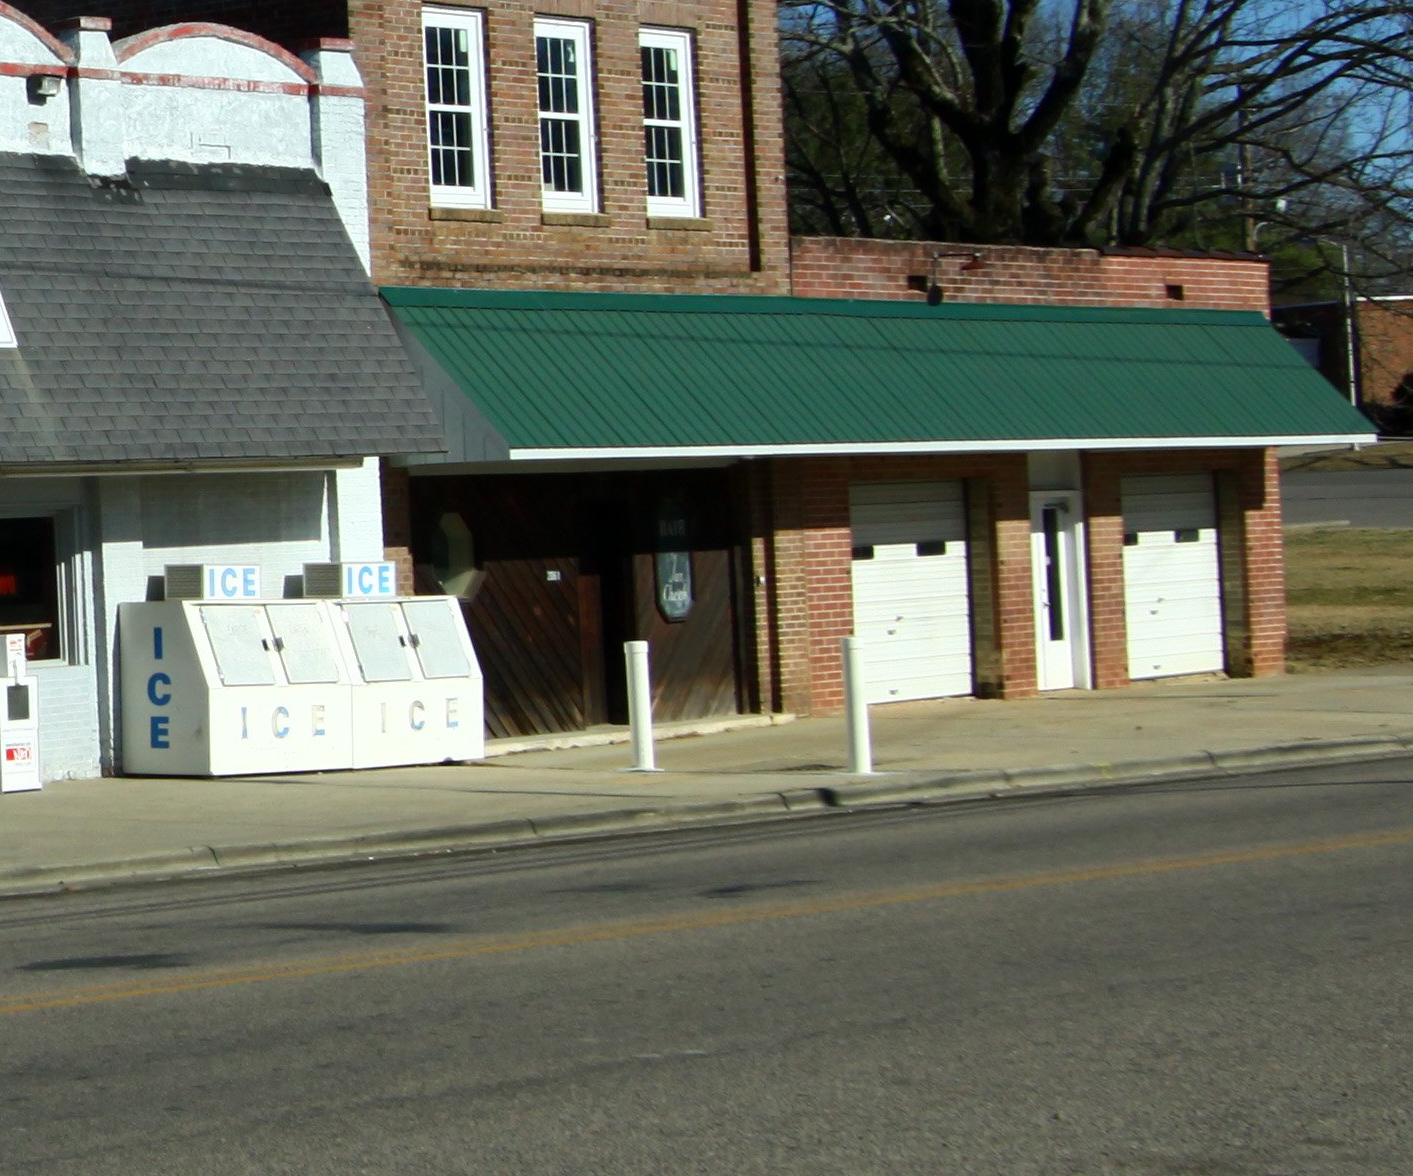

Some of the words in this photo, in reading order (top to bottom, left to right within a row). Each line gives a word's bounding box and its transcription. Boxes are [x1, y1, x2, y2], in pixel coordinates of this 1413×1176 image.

[209, 568, 255, 597] ICE
[347, 566, 390, 594] ICE
[147, 627, 171, 748] ICE
[240, 704, 326, 739] ICE
[379, 697, 459, 734] ICE
